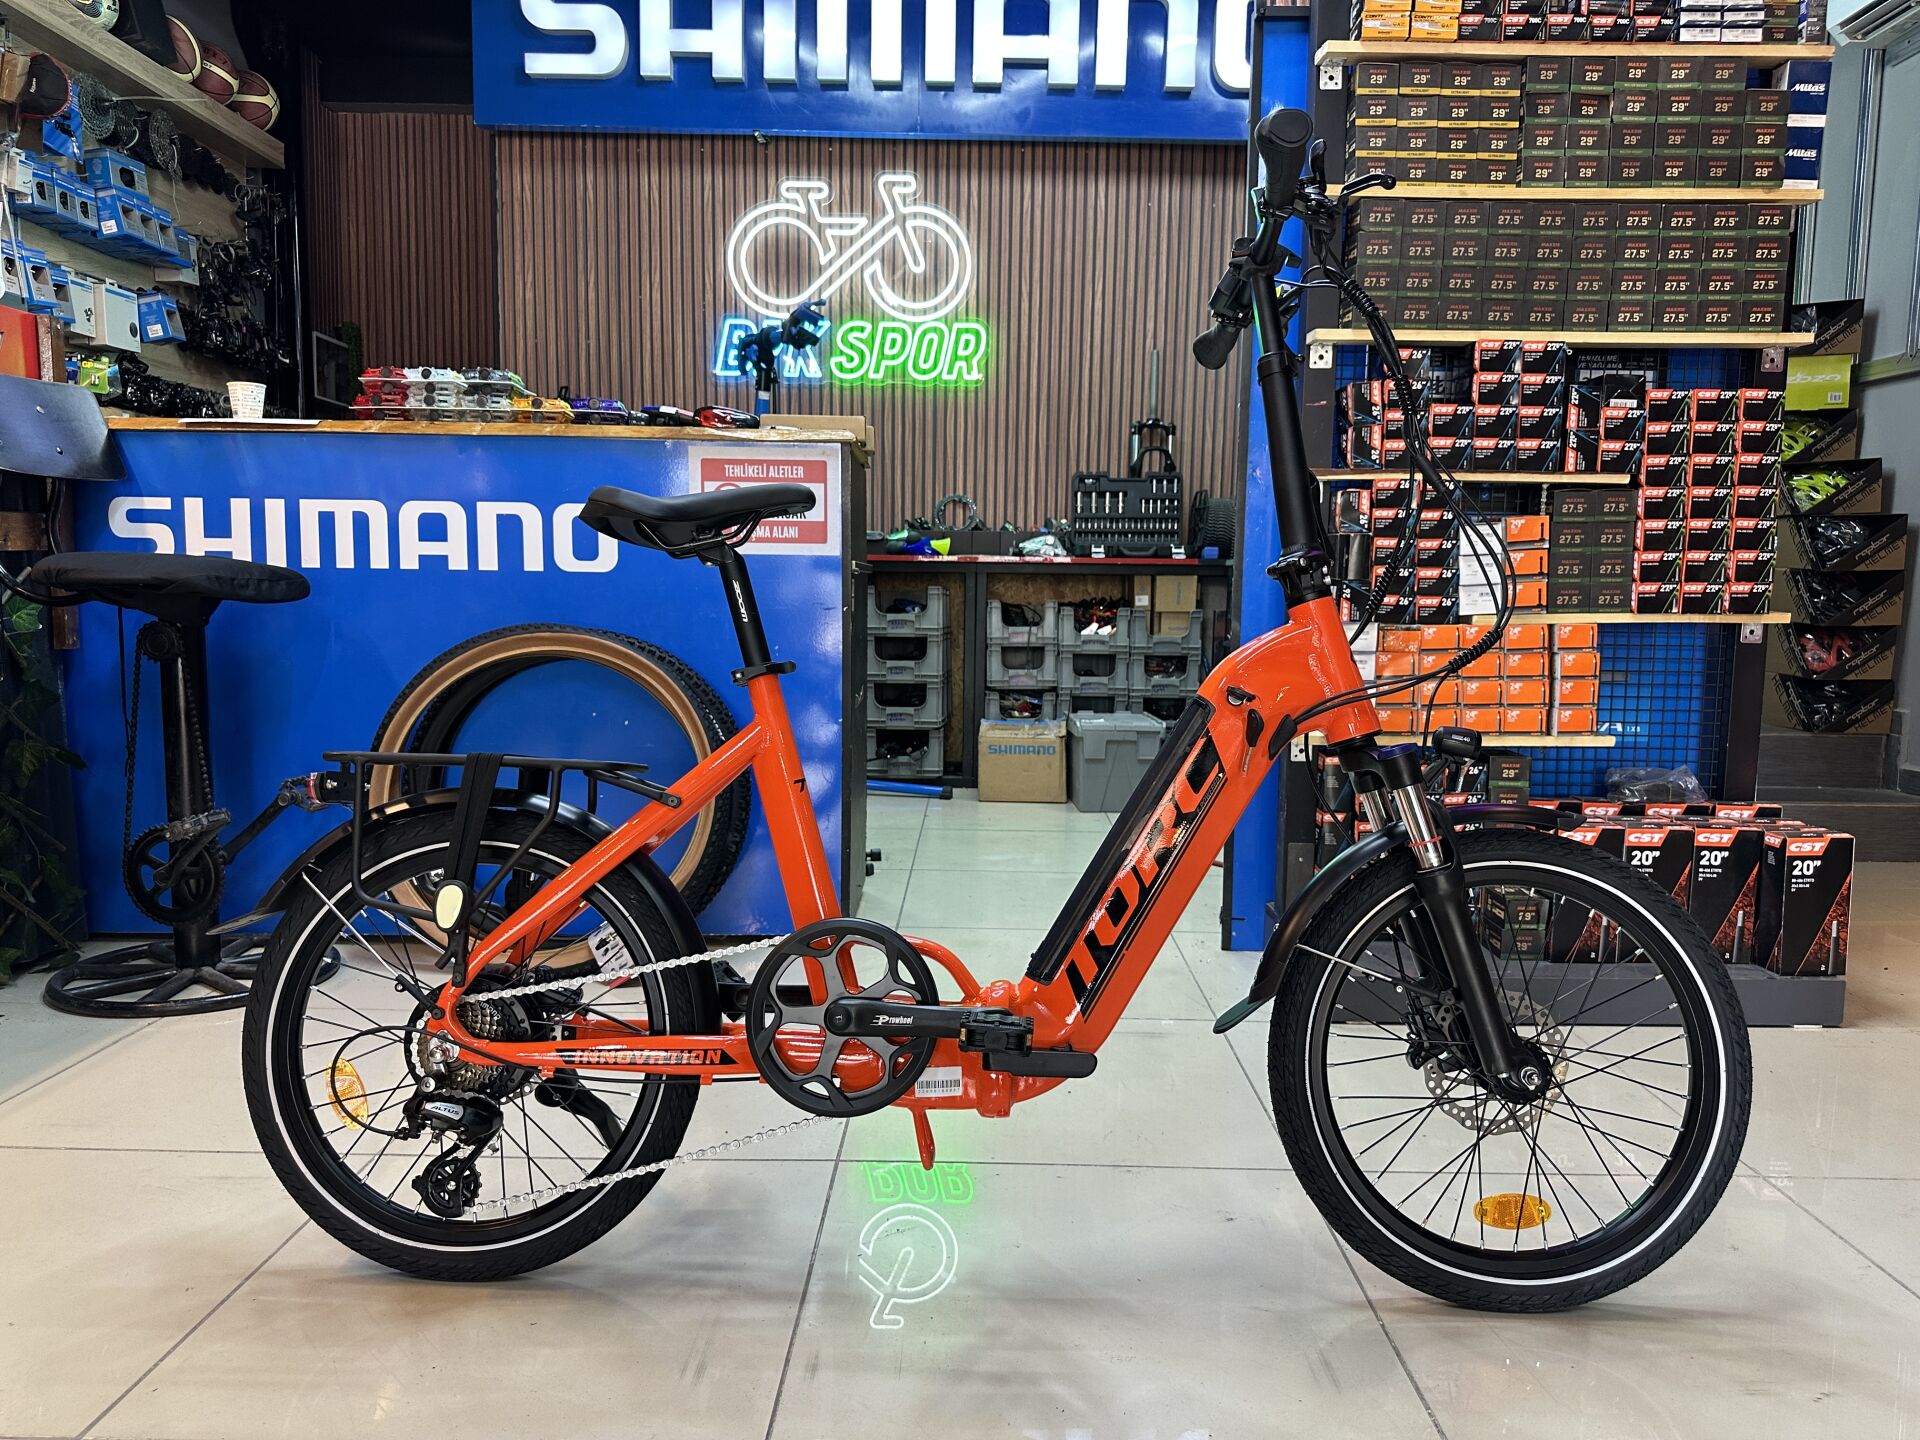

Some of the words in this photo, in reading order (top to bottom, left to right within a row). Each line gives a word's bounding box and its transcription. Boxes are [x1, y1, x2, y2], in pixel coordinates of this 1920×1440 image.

[1629, 68, 1646, 78] 29"
[1672, 69, 1689, 79] 29"
[1370, 74, 1387, 84] 29"
[1454, 76, 1471, 86] 29"
[1410, 107, 1428, 117] 29"
[1627, 102, 1644, 112] 29"
[1492, 108, 1509, 118] 29"
[1536, 136, 1553, 146] 29"
[1757, 135, 1774, 144] 29"
[1785, 149, 1817, 157] Mitas
[1756, 168, 1772, 177] 29"
[1369, 213, 1395, 222] 27.5"
[1455, 215, 1480, 224] 27.5"
[1626, 217, 1652, 226] 27.5"
[1758, 216, 1783, 225] 27.5"
[1409, 247, 1435, 256] 27.5"
[1495, 248, 1521, 257] 27.5"
[1756, 250, 1781, 259] 27.5"
[1533, 281, 1559, 290] 27.5"
[1665, 282, 1690, 291] 27.5"
[1404, 310, 1430, 320] 27.5"
[1823, 323, 1861, 353] HELMET
[830, 320, 986, 381] SPOR
[1819, 432, 1855, 460] HELMET
[724, 463, 766, 478] TEHLİKELİ
[769, 465, 804, 478] ALETLER
[1842, 482, 1881, 512] HELMET
[1562, 504, 1587, 513] 27.5"
[1603, 503, 1629, 512] 27.5"
[107, 496, 619, 573] SHIMANO
[772, 527, 798, 538] ALANI
[1442, 540, 1456, 548] 26"
[1864, 539, 1905, 569] HELMET
[1442, 570, 1456, 578] 26"
[1638, 584, 1659, 592] CST
[1684, 584, 1704, 592] CST
[1731, 584, 1751, 592] CST
[1442, 598, 1456, 606] 26"
[1862, 595, 1903, 624] HELMET
[1854, 650, 1893, 678] HELMET
[1854, 704, 1891, 731] HELMET
[987, 744, 1056, 756] SHIMANO
[1584, 807, 1617, 816] CST
[1718, 810, 1753, 818] CST
[1628, 833, 1665, 842] CST
[1697, 833, 1733, 842] CST
[1764, 836, 1781, 845] CST
[1789, 842, 1825, 852] CST
[1631, 851, 1660, 865] 20"
[1700, 850, 1729, 865] 20"
[1792, 860, 1822, 875] 20"
[870, 1014, 914, 1025] Prowheel
[574, 1048, 721, 1065] INNOVATION
[431, 1106, 460, 1115] ALTUS
